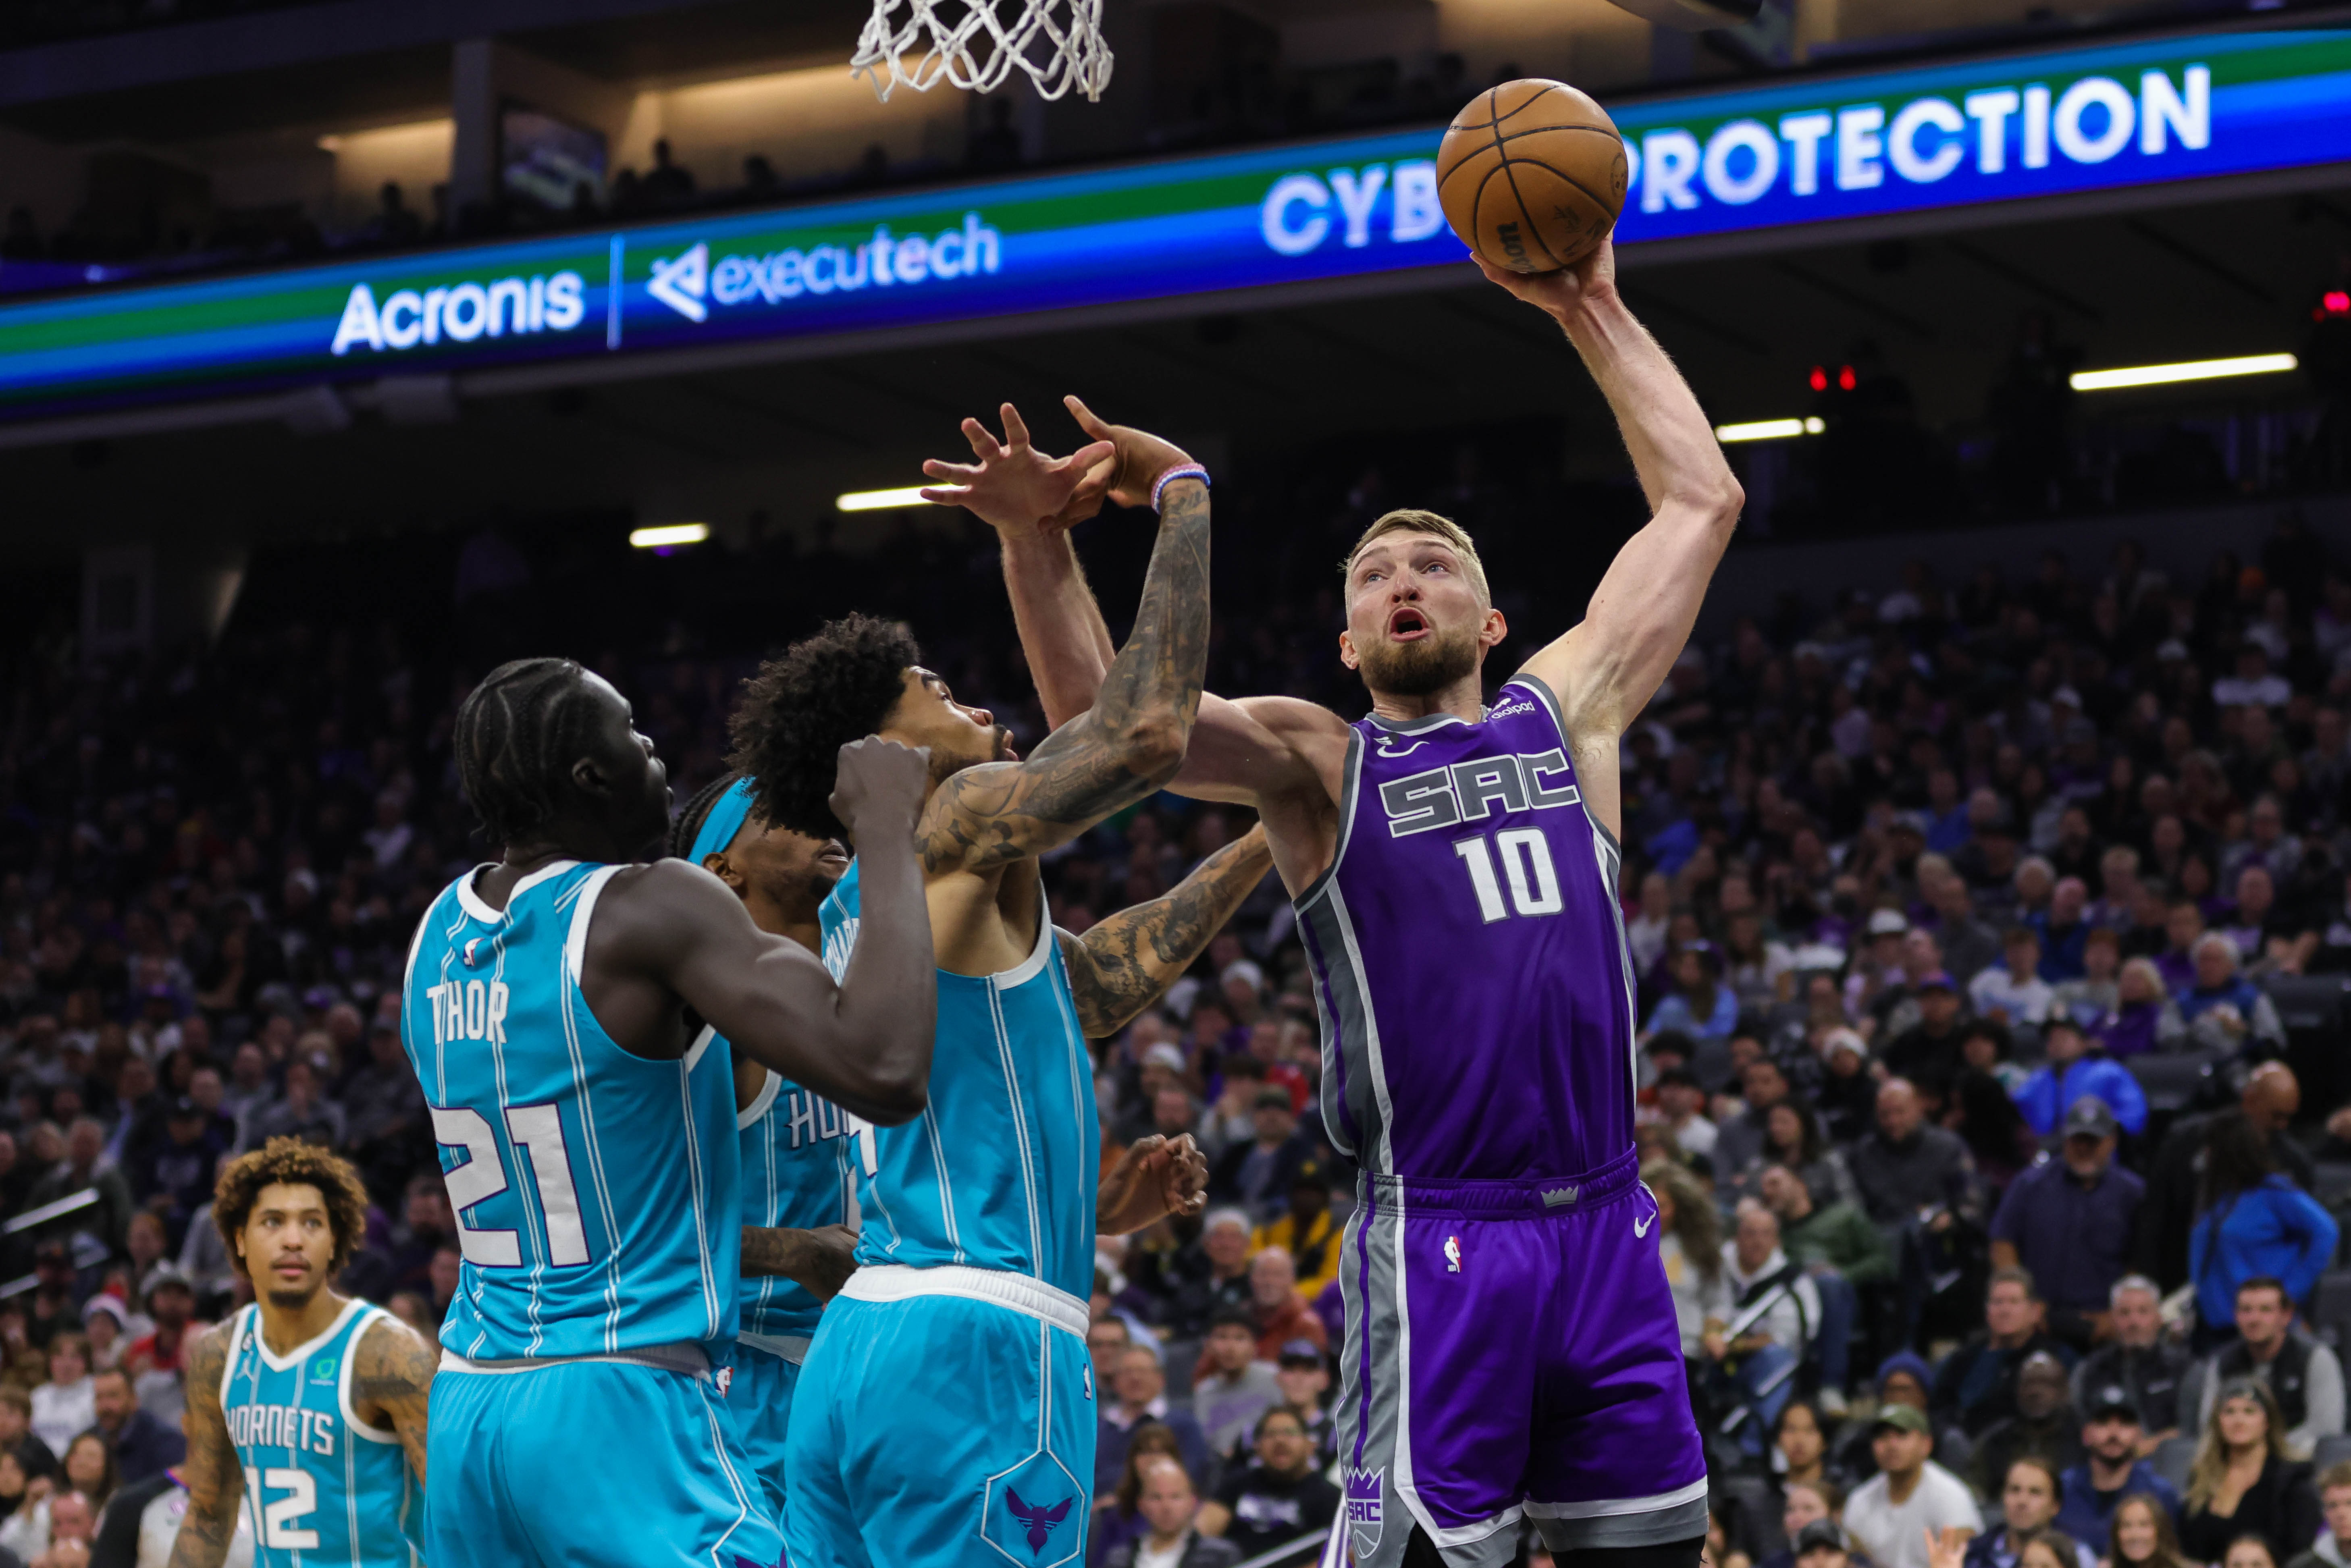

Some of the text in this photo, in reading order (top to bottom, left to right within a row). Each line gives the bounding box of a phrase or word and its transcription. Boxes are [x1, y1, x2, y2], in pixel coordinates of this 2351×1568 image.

[1261, 158, 1448, 256] CYB
[711, 211, 1001, 305] executech
[1491, 700, 1536, 719] dialpad
[1378, 747, 1582, 838] SAC
[1451, 826, 1565, 924] 10
[426, 979, 510, 1045] THOR
[431, 1101, 592, 1268] 21
[224, 1404, 335, 1456] HORNETS
[244, 1466, 319, 1549] 12
[1347, 1501, 1381, 1522] SAC
